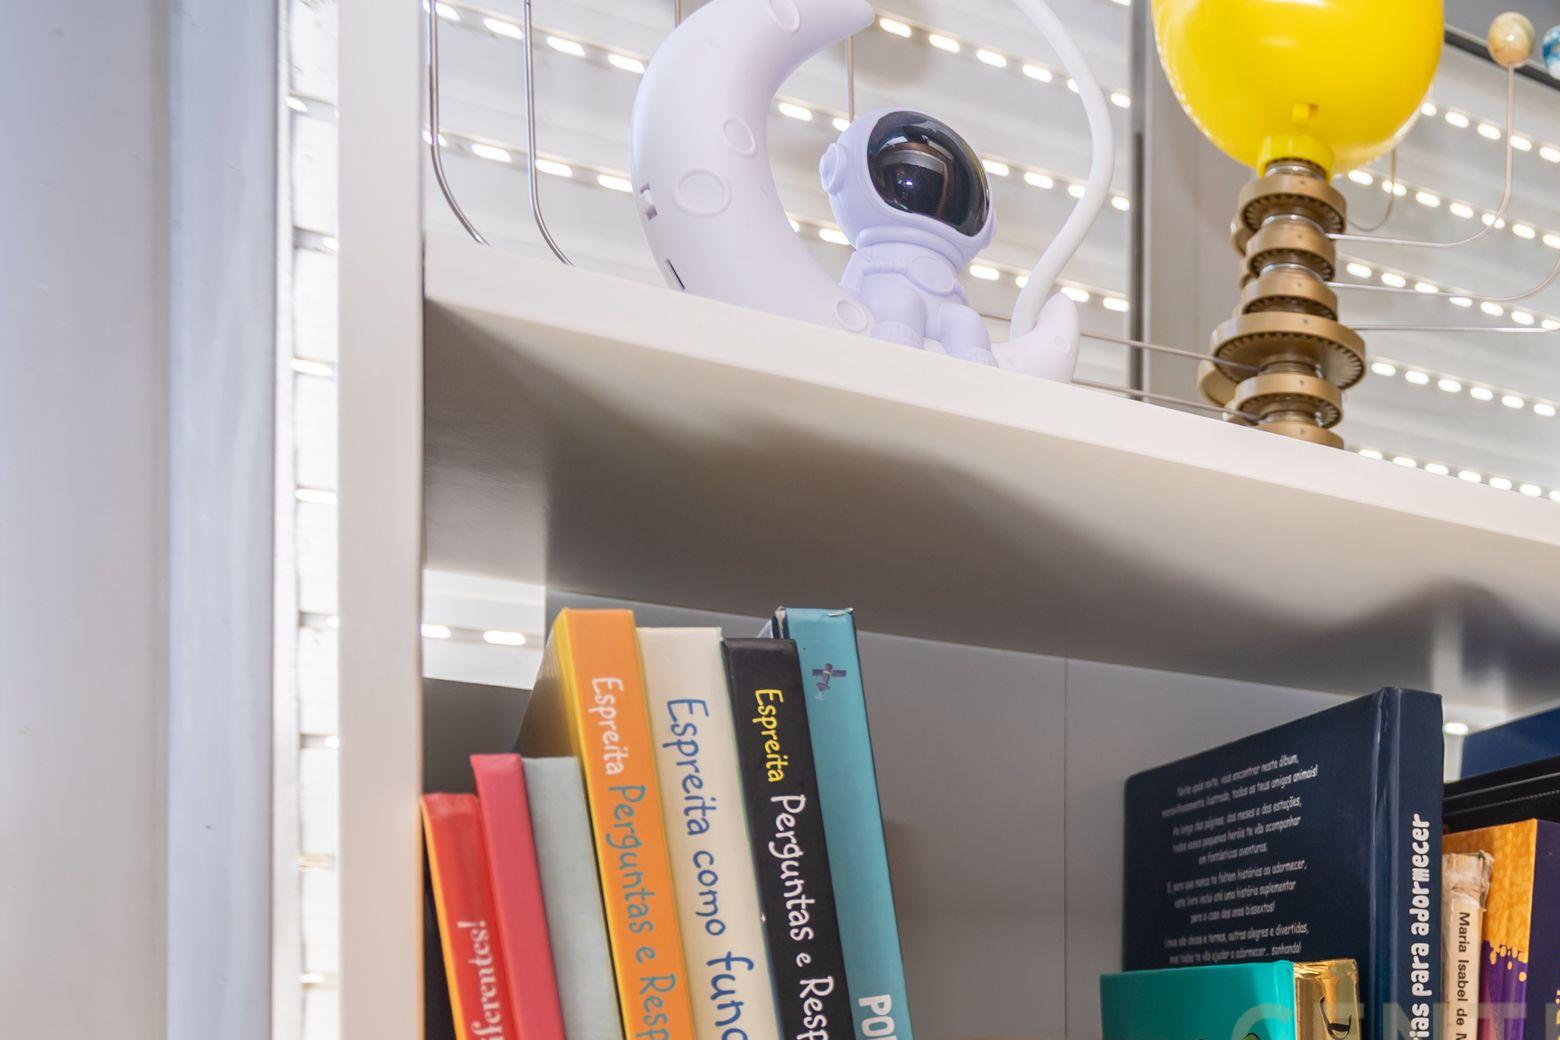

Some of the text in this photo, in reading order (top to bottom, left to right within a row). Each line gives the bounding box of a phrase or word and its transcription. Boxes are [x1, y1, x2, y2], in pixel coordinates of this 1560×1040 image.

[588, 676, 624, 776] Espreita
[607, 784, 655, 934] Perguntas
[663, 698, 710, 836] Espreita
[693, 850, 725, 937] como
[752, 688, 784, 782] Espreita
[768, 795, 814, 941] Perguntas
[1408, 813, 1431, 936] adormecer
[1410, 944, 1432, 997] para
[1458, 911, 1470, 952] Maria
[1455, 1008, 1468, 1026] de
[1456, 958, 1469, 1001] Isabel
